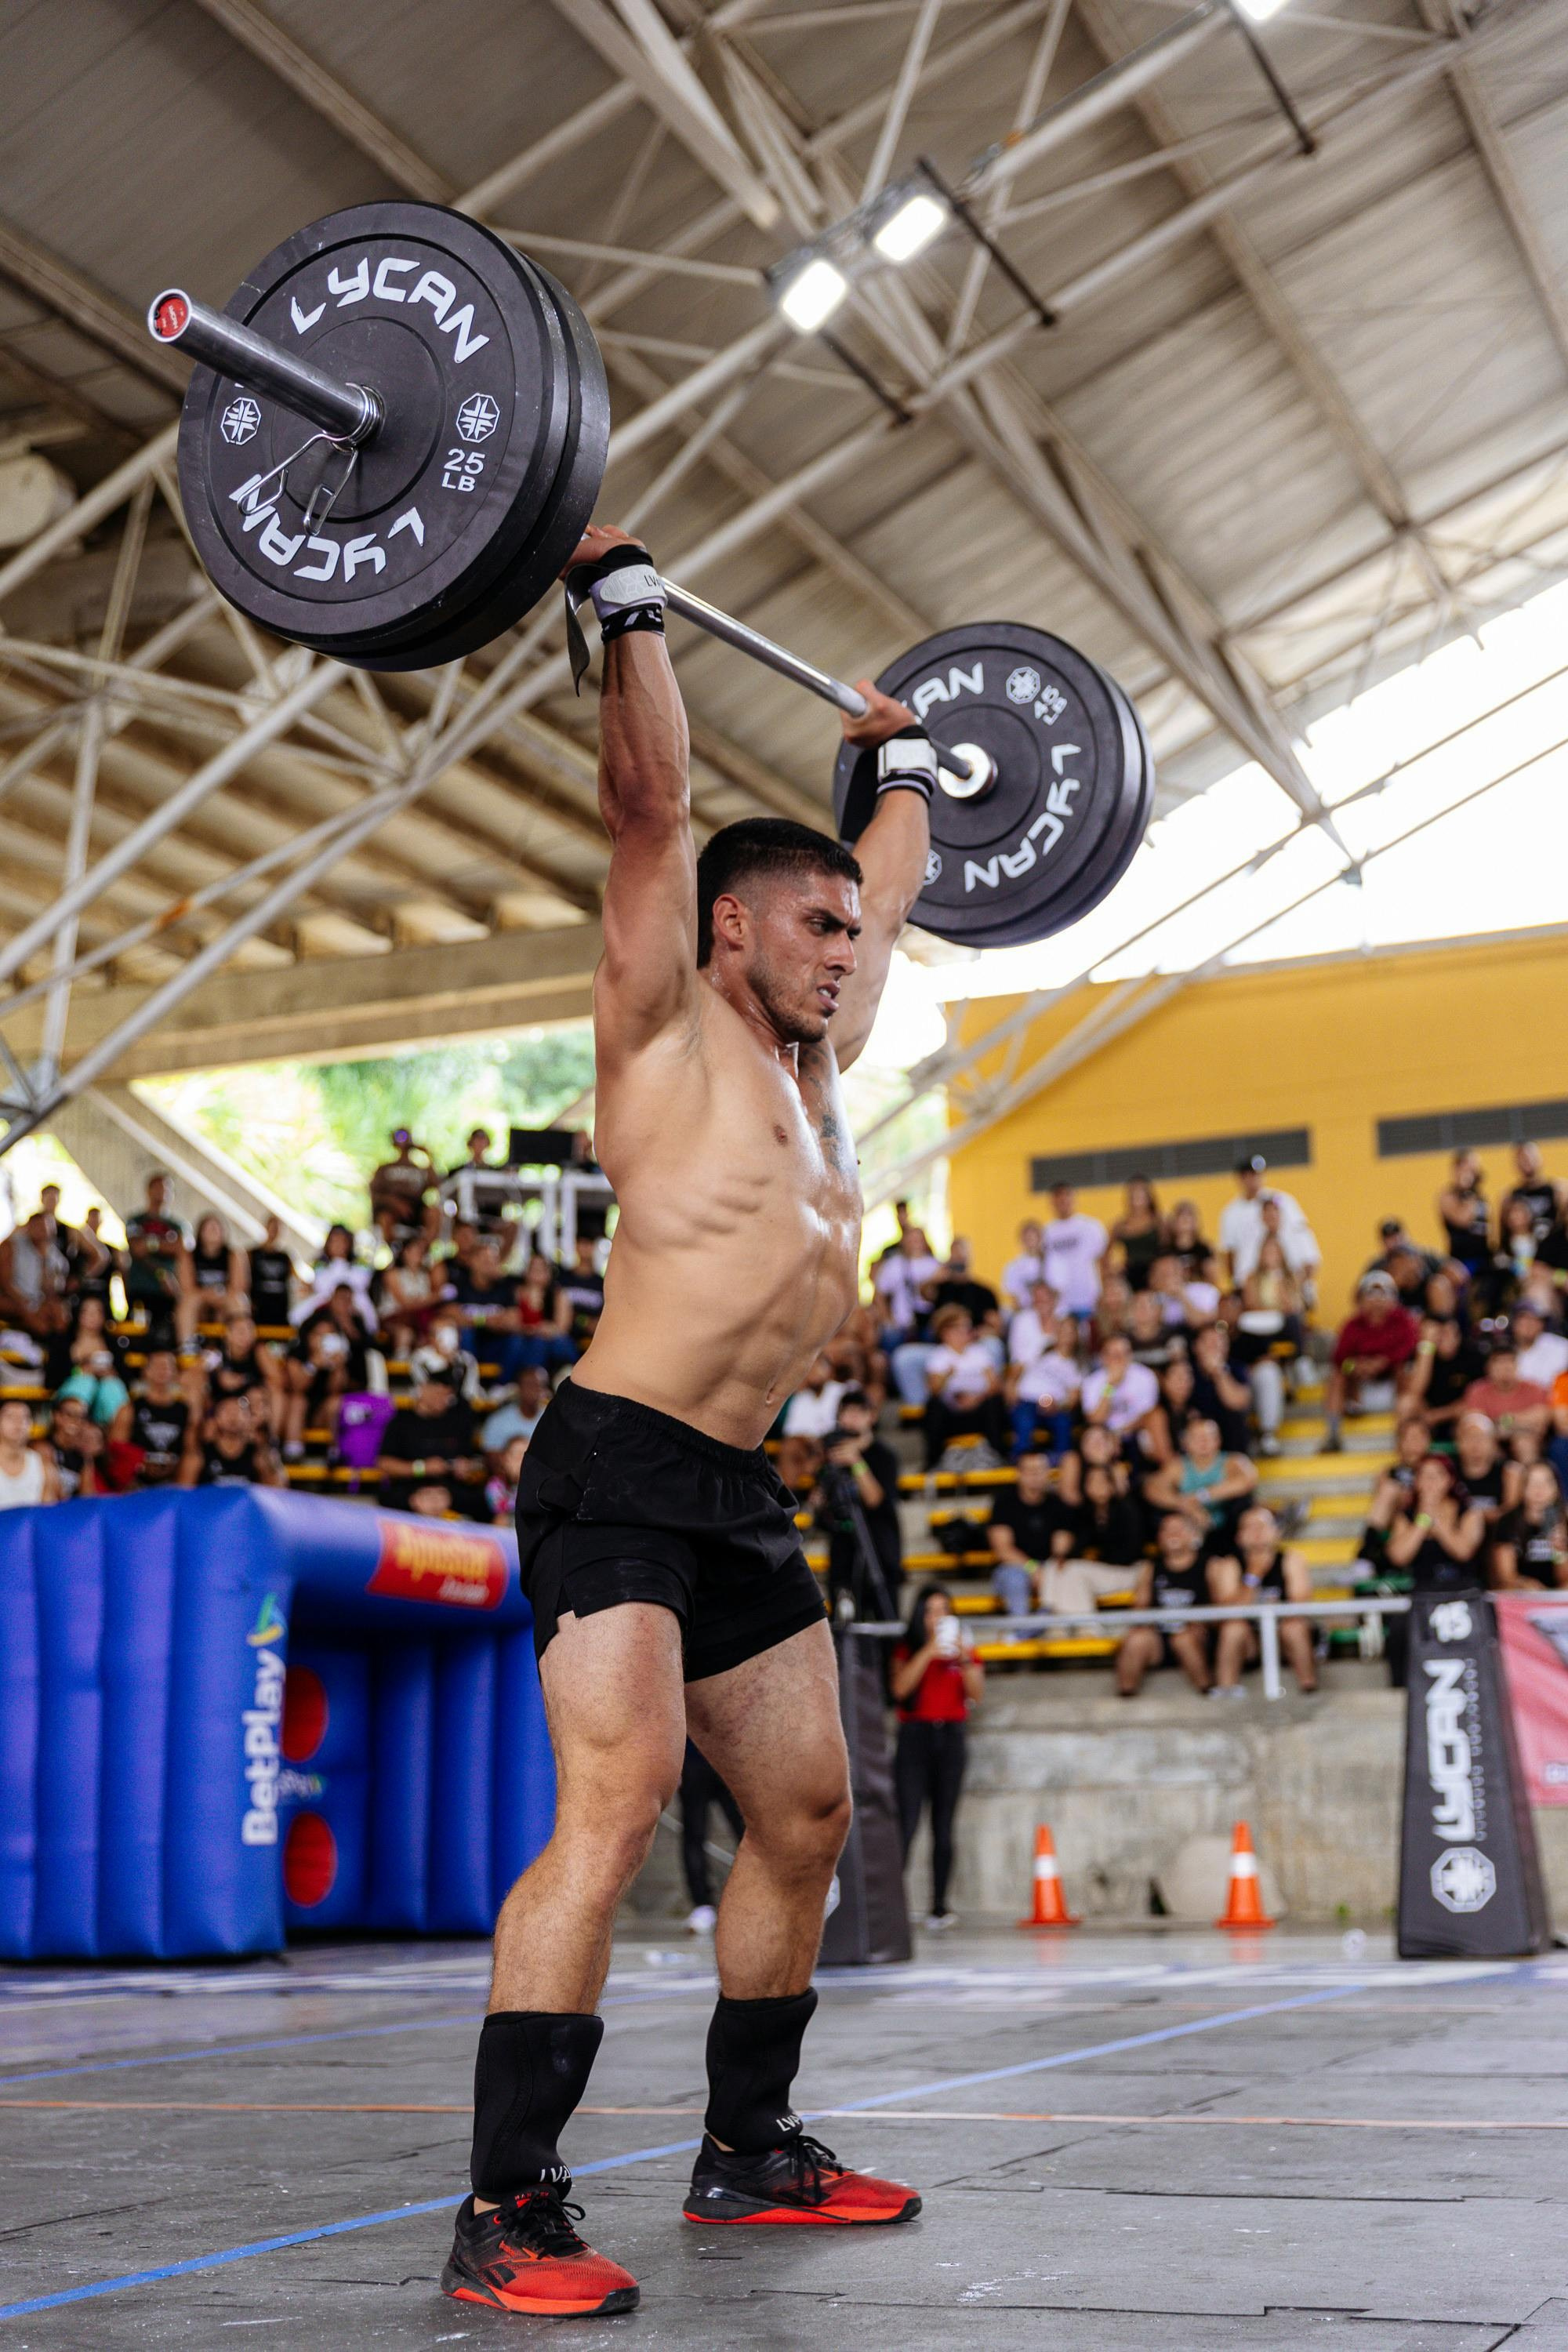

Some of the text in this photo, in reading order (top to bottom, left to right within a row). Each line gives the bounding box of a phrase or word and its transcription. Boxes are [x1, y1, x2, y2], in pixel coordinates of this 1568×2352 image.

[290, 256, 490, 364] LYCAN
[441, 472, 475, 492] LB
[443, 448, 485, 475] 25
[228, 474, 425, 583] LYCAN
[1034, 684, 1062, 720] 45
[1042, 696, 1068, 727] LB
[964, 743, 1082, 893] LYCAN
[1422, 1657, 1476, 1842] LYCAN
